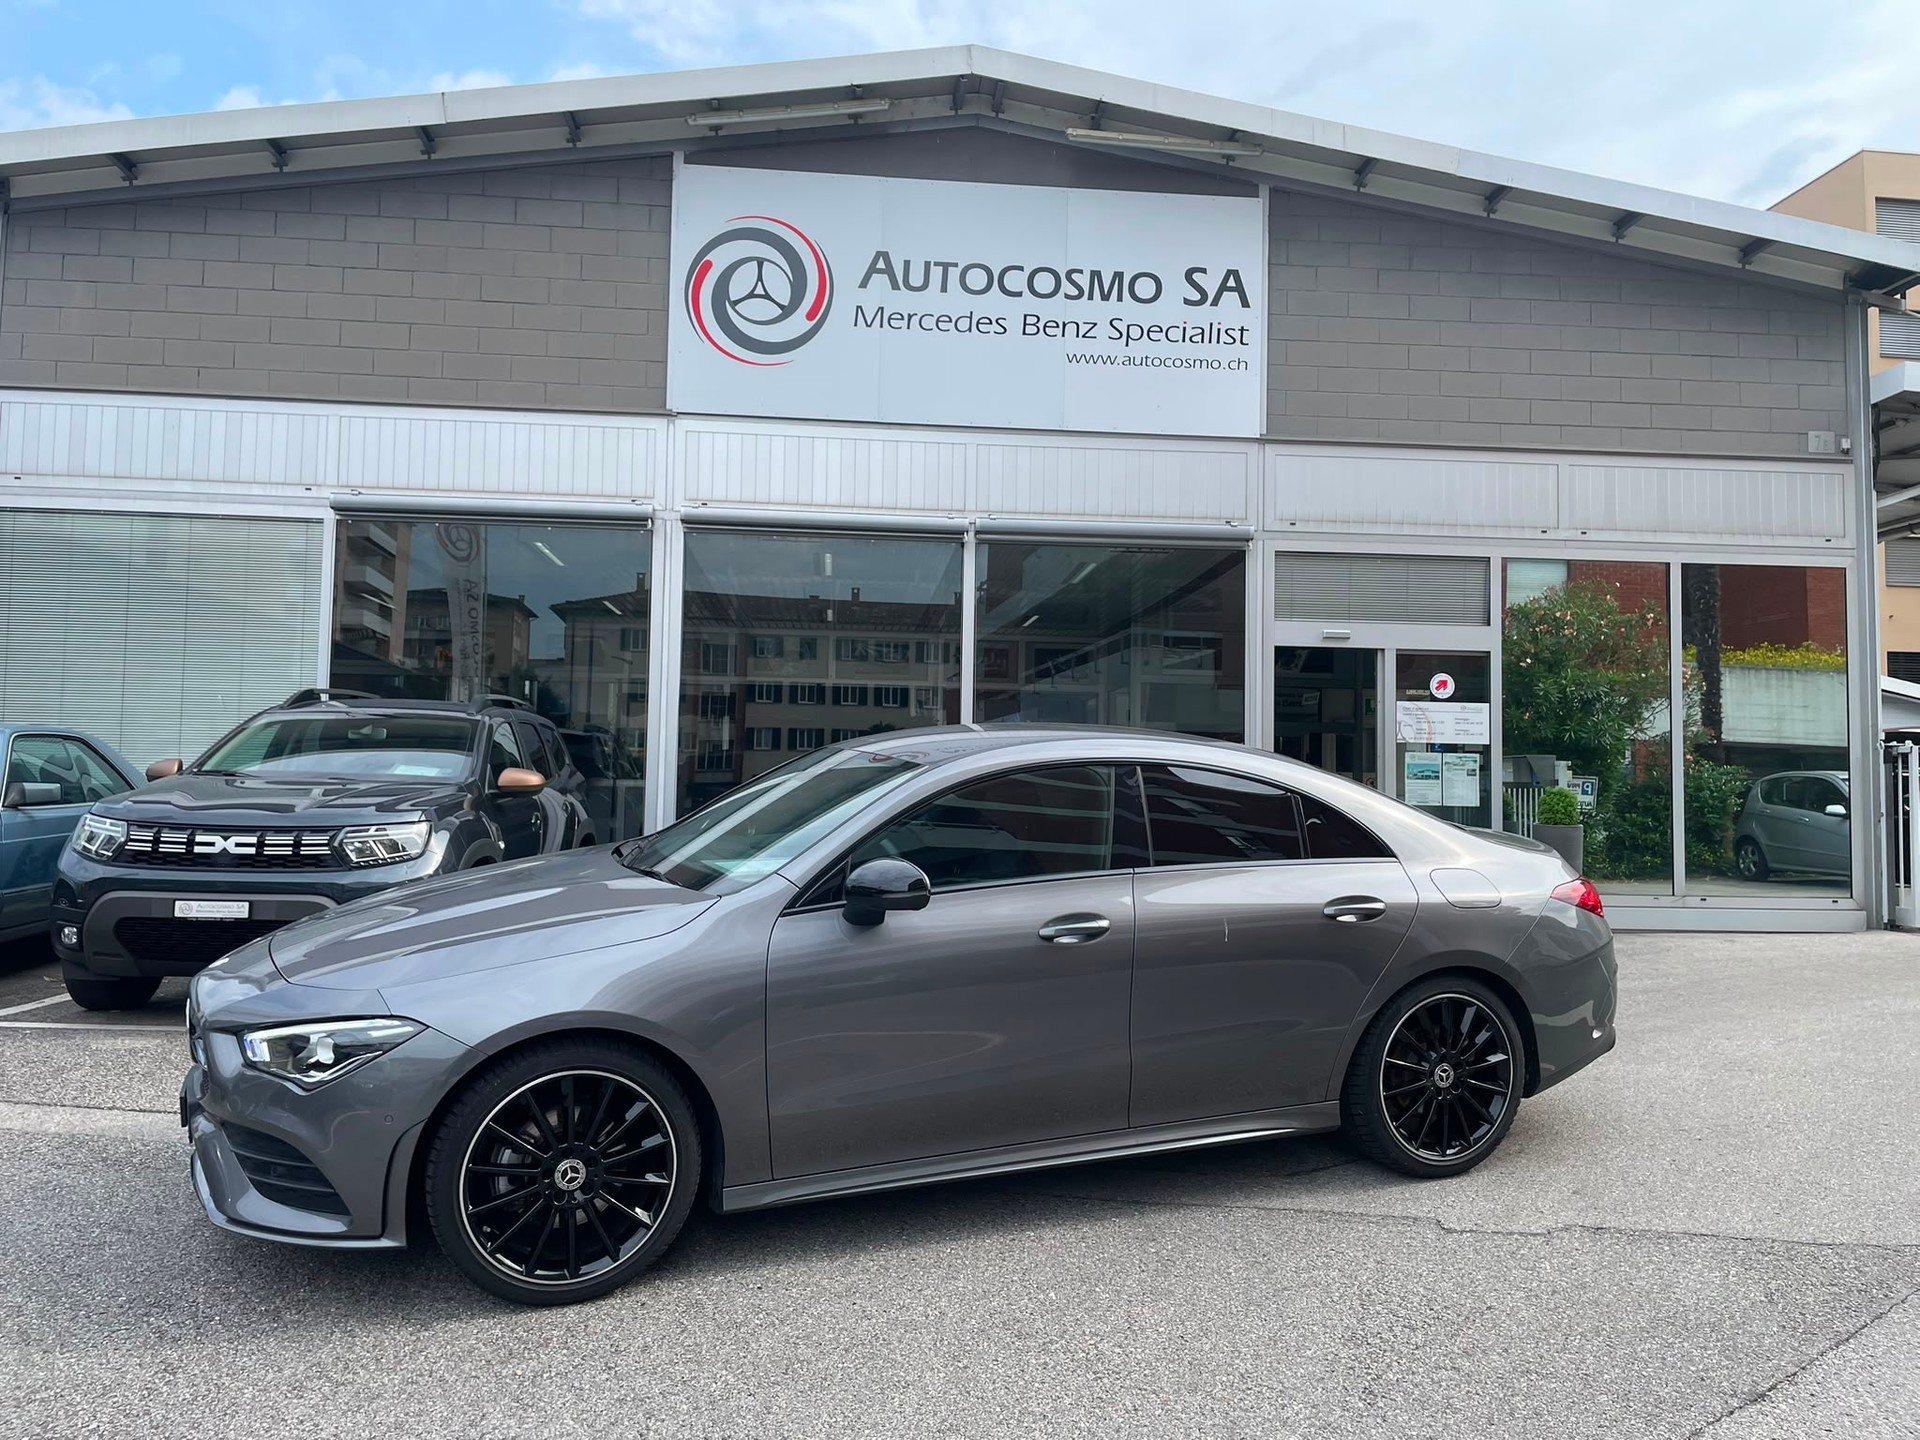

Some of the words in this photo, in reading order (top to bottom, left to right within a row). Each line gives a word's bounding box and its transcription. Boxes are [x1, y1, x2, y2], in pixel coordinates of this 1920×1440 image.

[858, 250, 1163, 304] AUTOCOSMO
[1182, 266, 1252, 309] SA
[853, 304, 1008, 337] Mercedes
[1022, 313, 1098, 340] Benz
[1108, 317, 1251, 348] Specialist
[1066, 352, 1250, 371] www.autocosmo.ch
